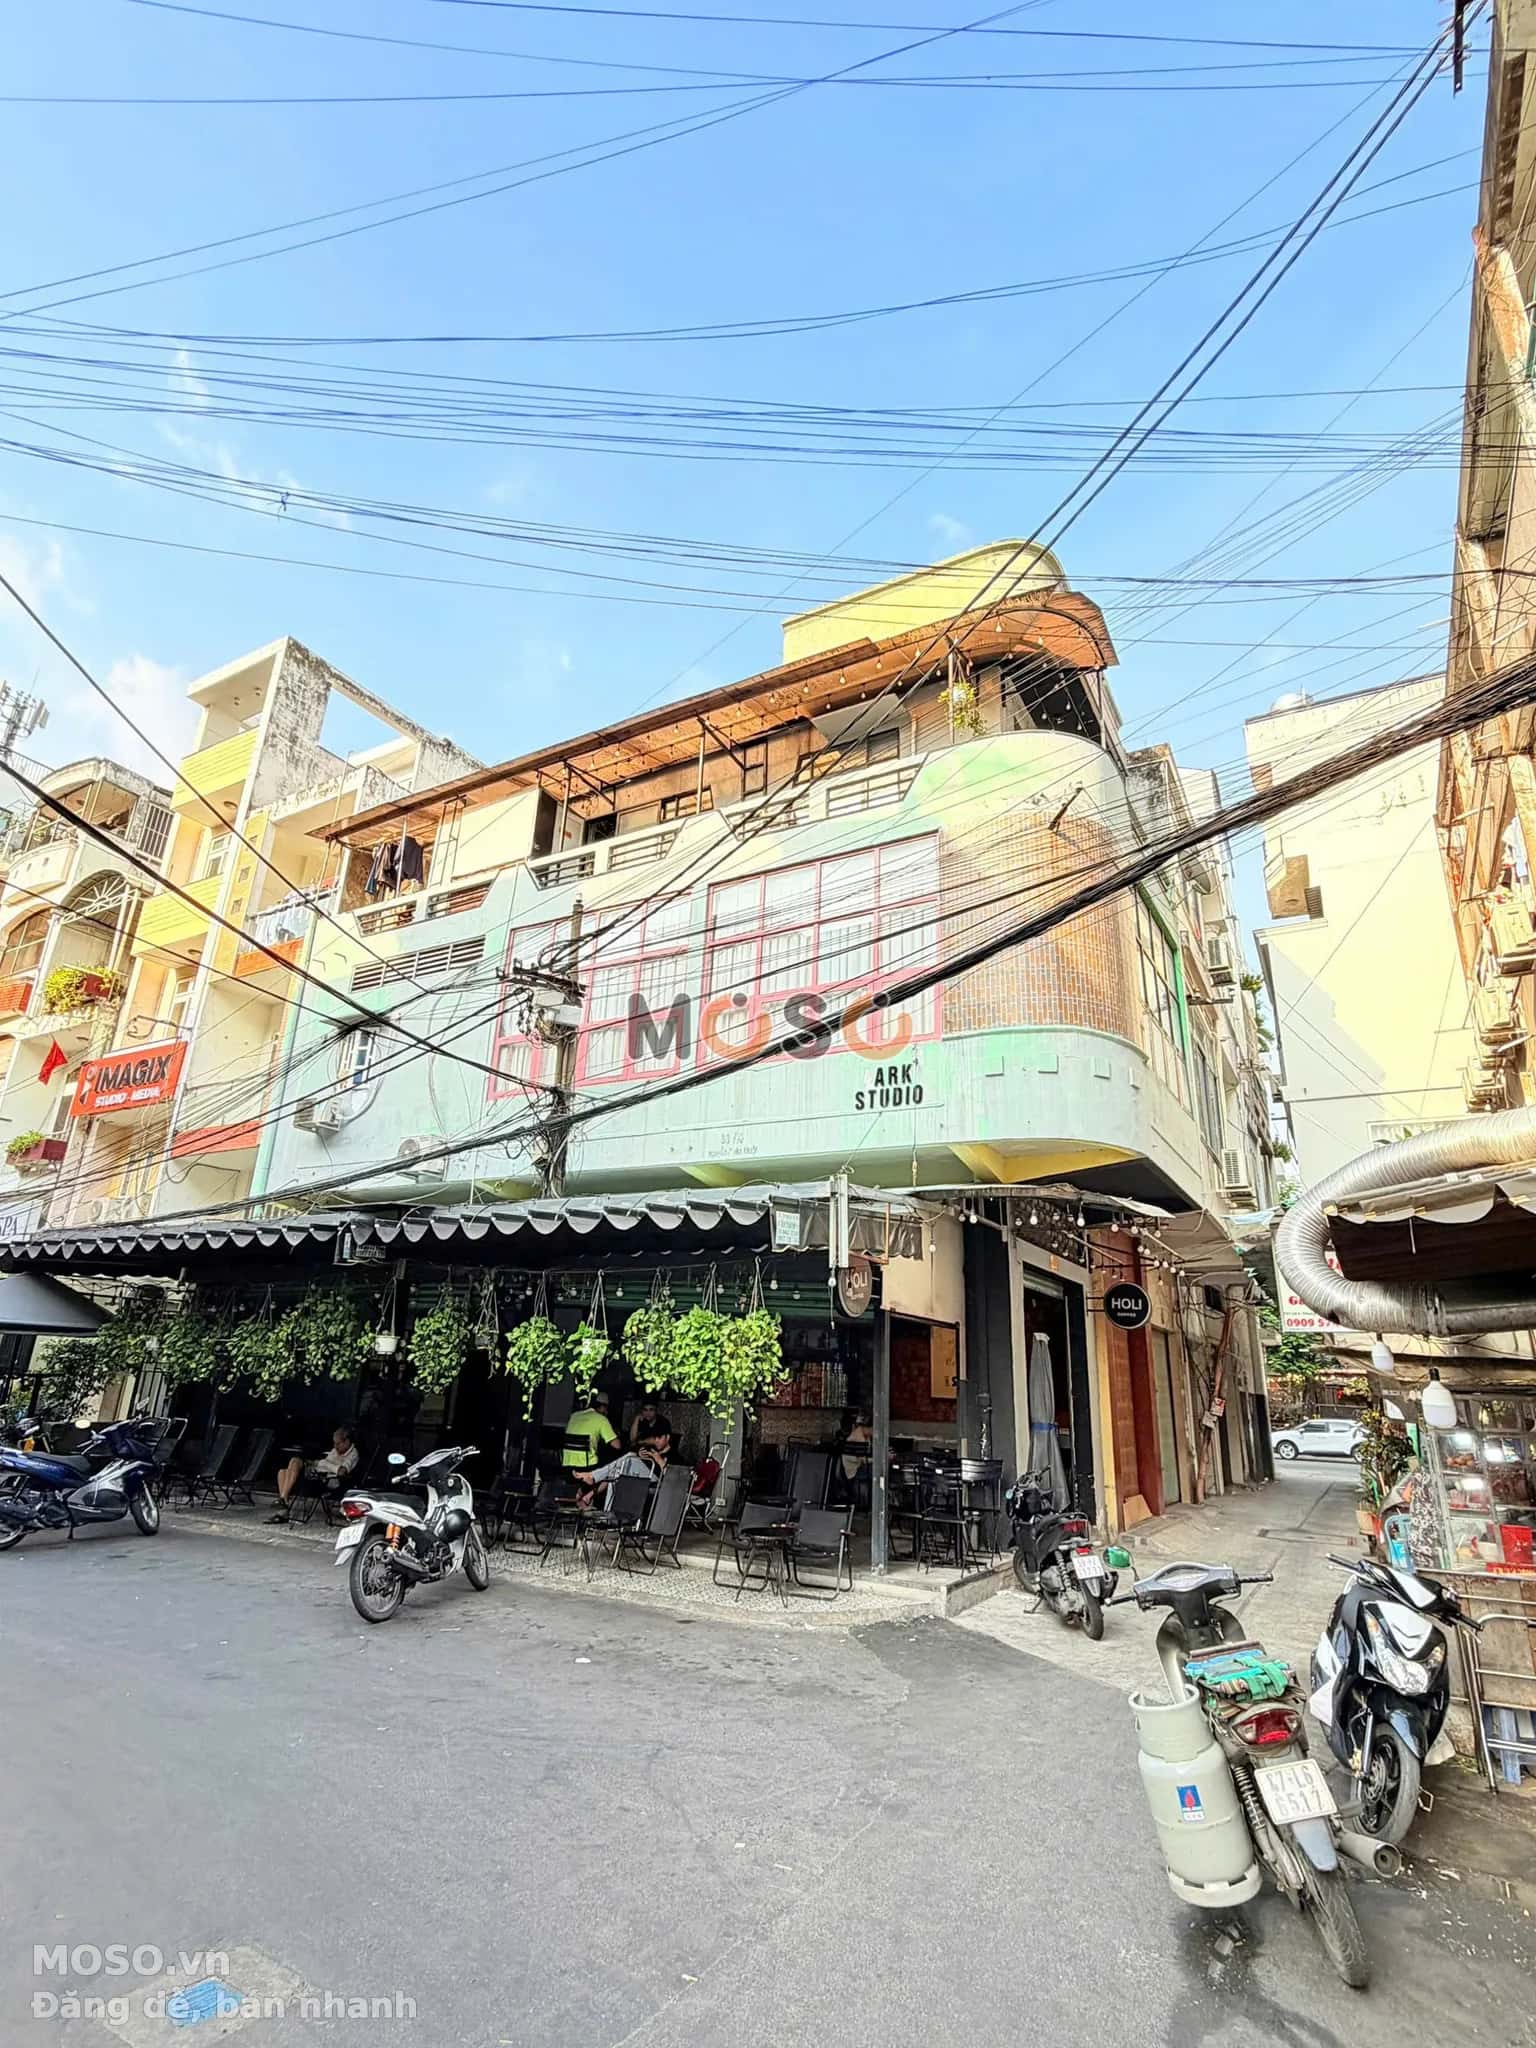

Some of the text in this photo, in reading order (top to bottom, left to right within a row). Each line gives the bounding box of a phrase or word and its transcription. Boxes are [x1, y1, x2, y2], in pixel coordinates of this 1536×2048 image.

[95, 1055, 172, 1094] IMAGIX
[875, 1064, 912, 1087] ARK
[855, 1085, 923, 1110] STUDIO
[1111, 1297, 1143, 1310] HOLI
